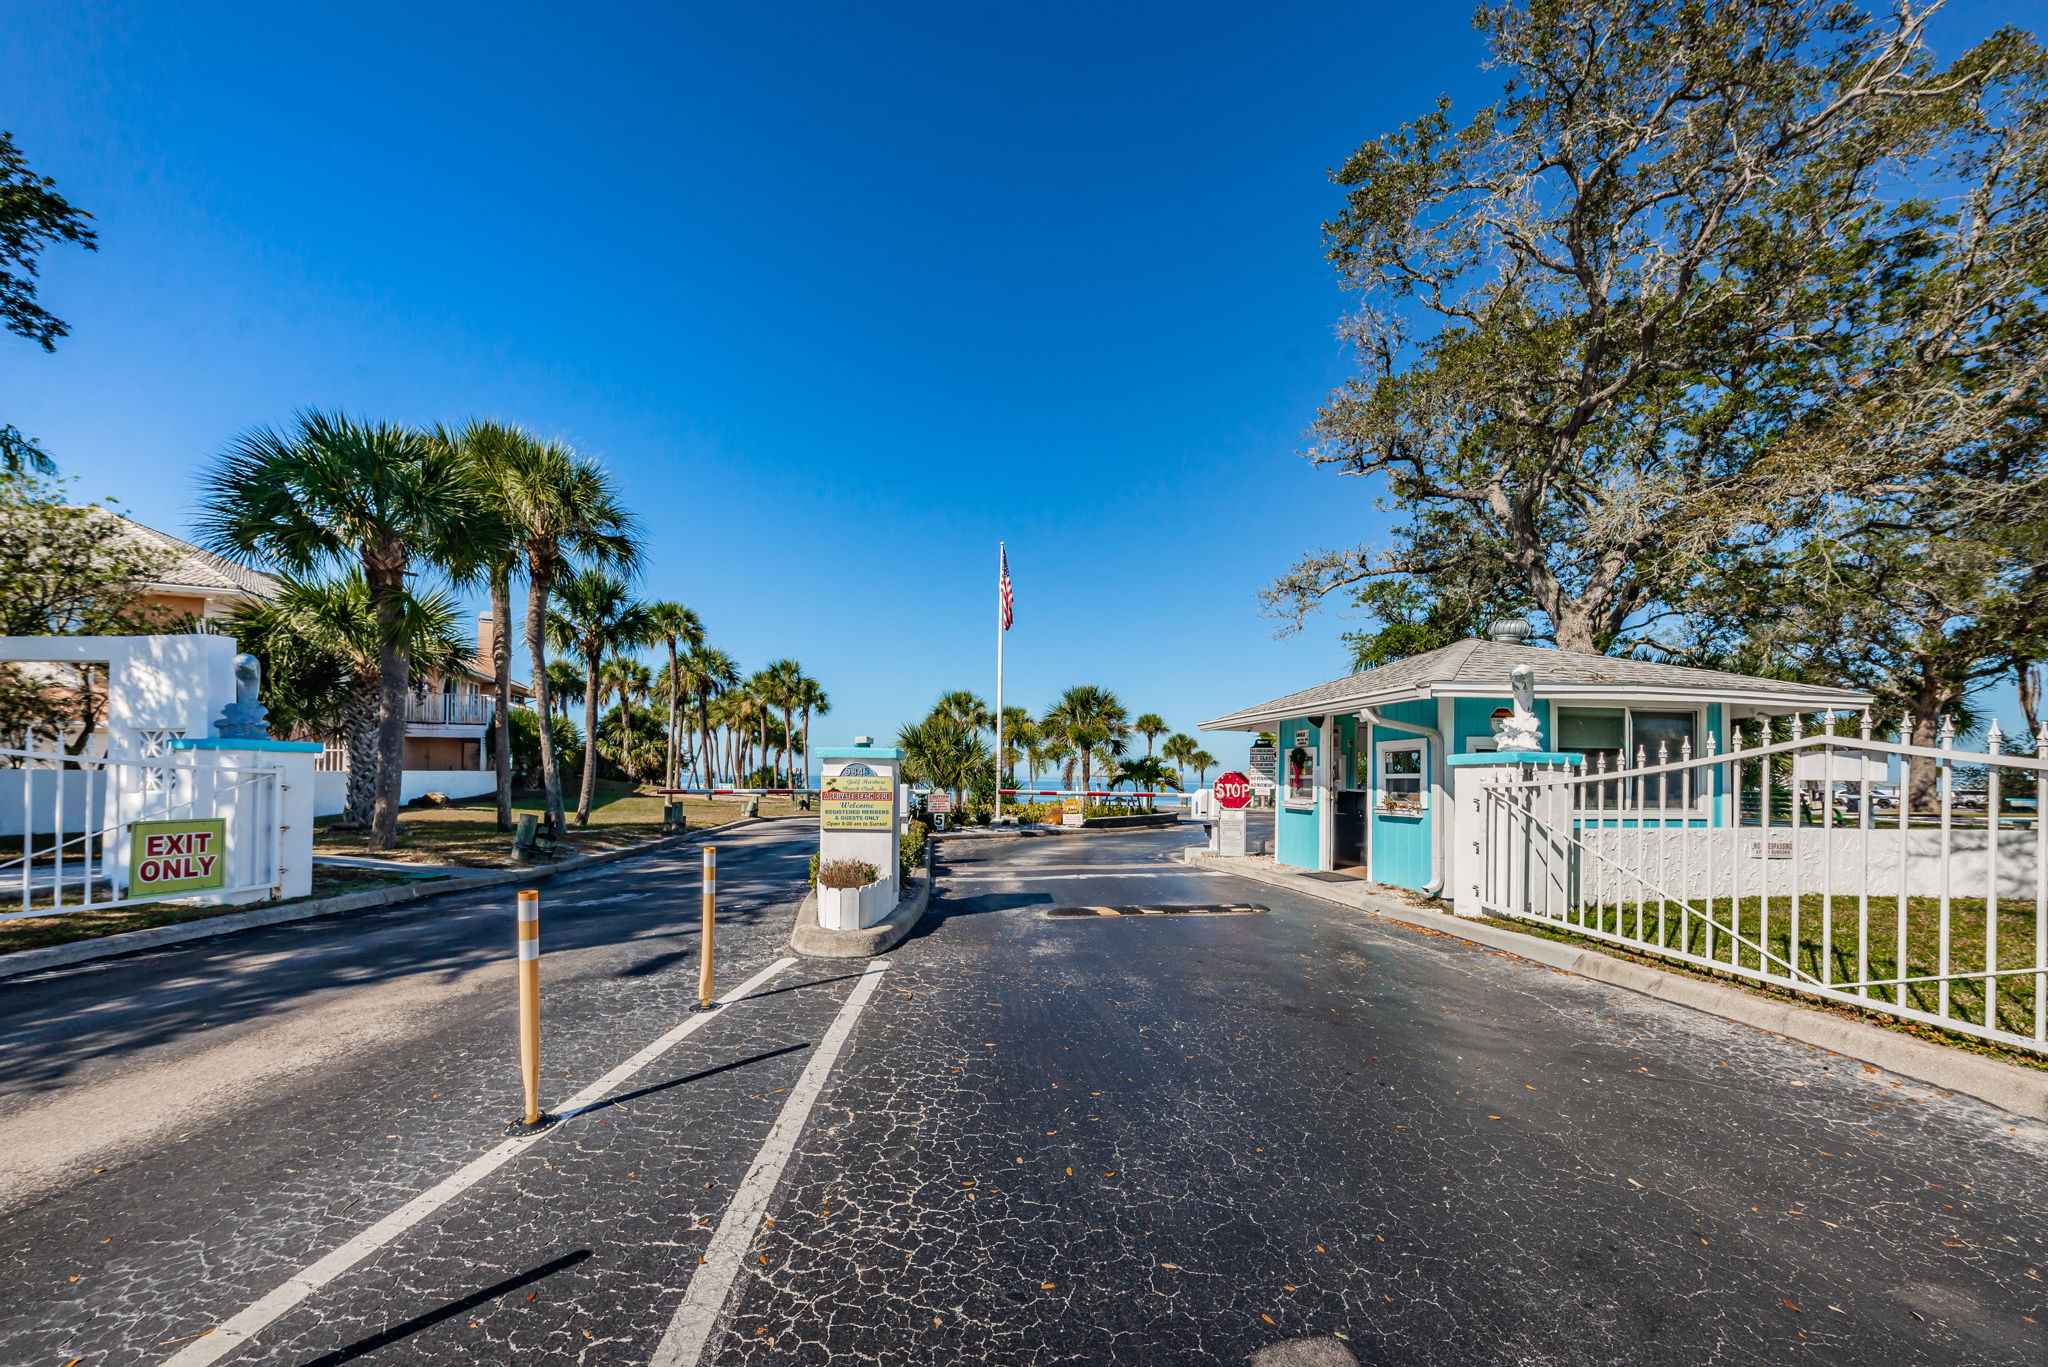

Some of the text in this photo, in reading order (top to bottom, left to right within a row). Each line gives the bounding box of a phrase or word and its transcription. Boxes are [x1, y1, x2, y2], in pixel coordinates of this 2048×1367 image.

[1216, 783, 1250, 798] STOP
[935, 815, 942, 825] 5
[146, 832, 213, 857] EXIT
[138, 855, 217, 883] ONLY
